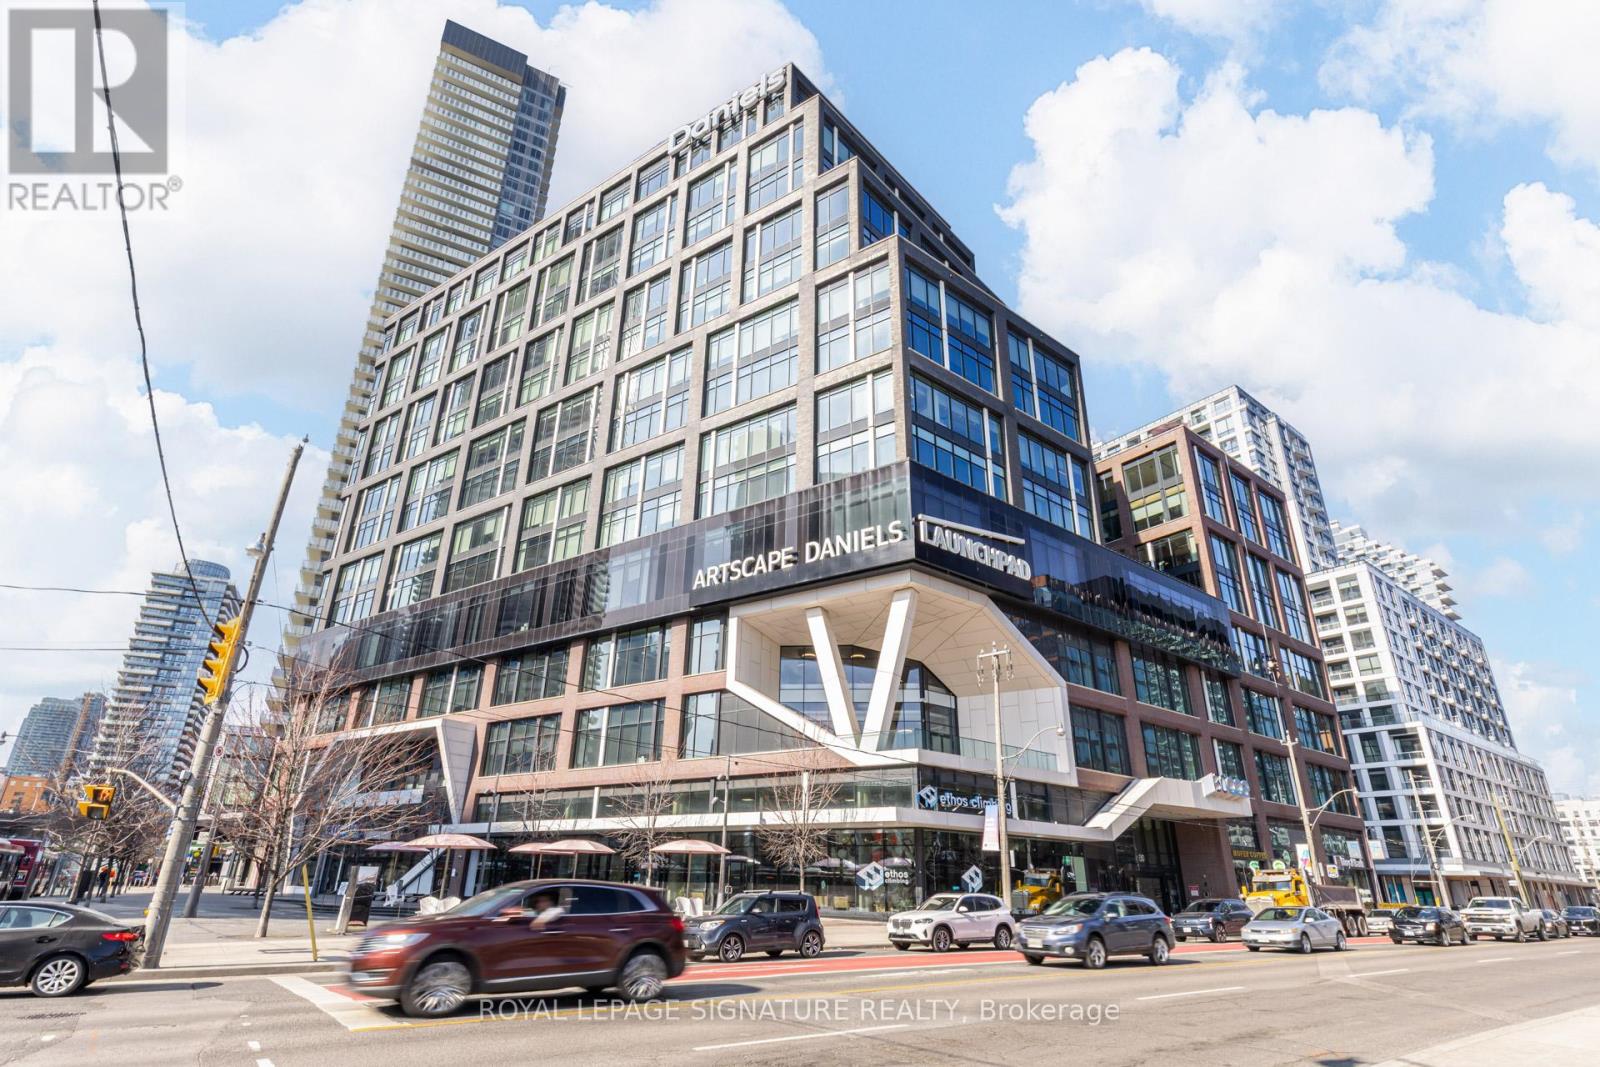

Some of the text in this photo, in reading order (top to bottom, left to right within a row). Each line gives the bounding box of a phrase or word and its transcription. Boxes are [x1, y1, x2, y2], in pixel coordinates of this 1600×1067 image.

[668, 66, 786, 156] Daniels
[692, 519, 905, 591] ARTSCAPE DANIELS
[918, 519, 1032, 581] LAUNCHPAD
[939, 792, 969, 807] ethos
[884, 868, 909, 879] ethos
